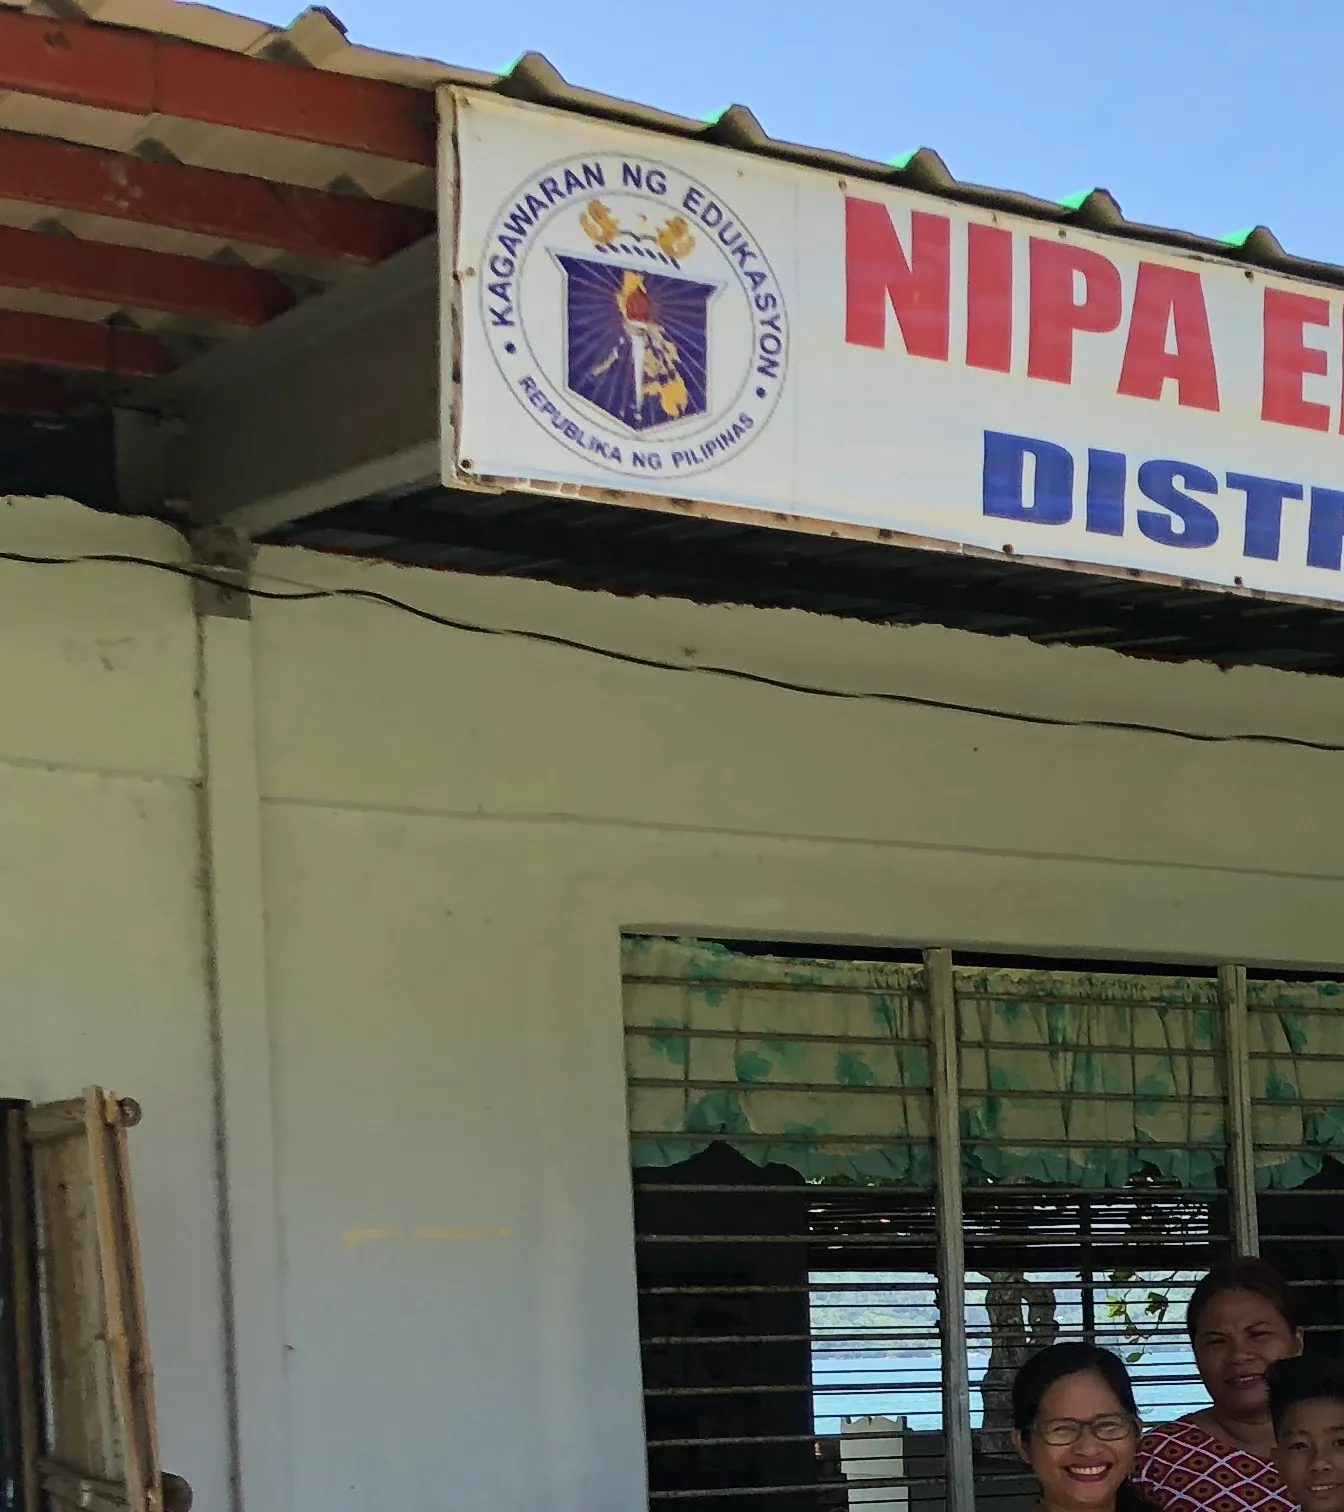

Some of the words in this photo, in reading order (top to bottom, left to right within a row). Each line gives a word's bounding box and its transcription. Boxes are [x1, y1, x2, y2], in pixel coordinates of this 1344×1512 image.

[488, 161, 605, 328] KAGAWARAN
[621, 162, 668, 196] NG
[682, 186, 783, 379] EDUKASYON
[845, 196, 1220, 412] NIPA
[519, 374, 622, 464] REPUBLIKA
[632, 451, 663, 470] NG
[671, 411, 755, 469] PILIPINAS
